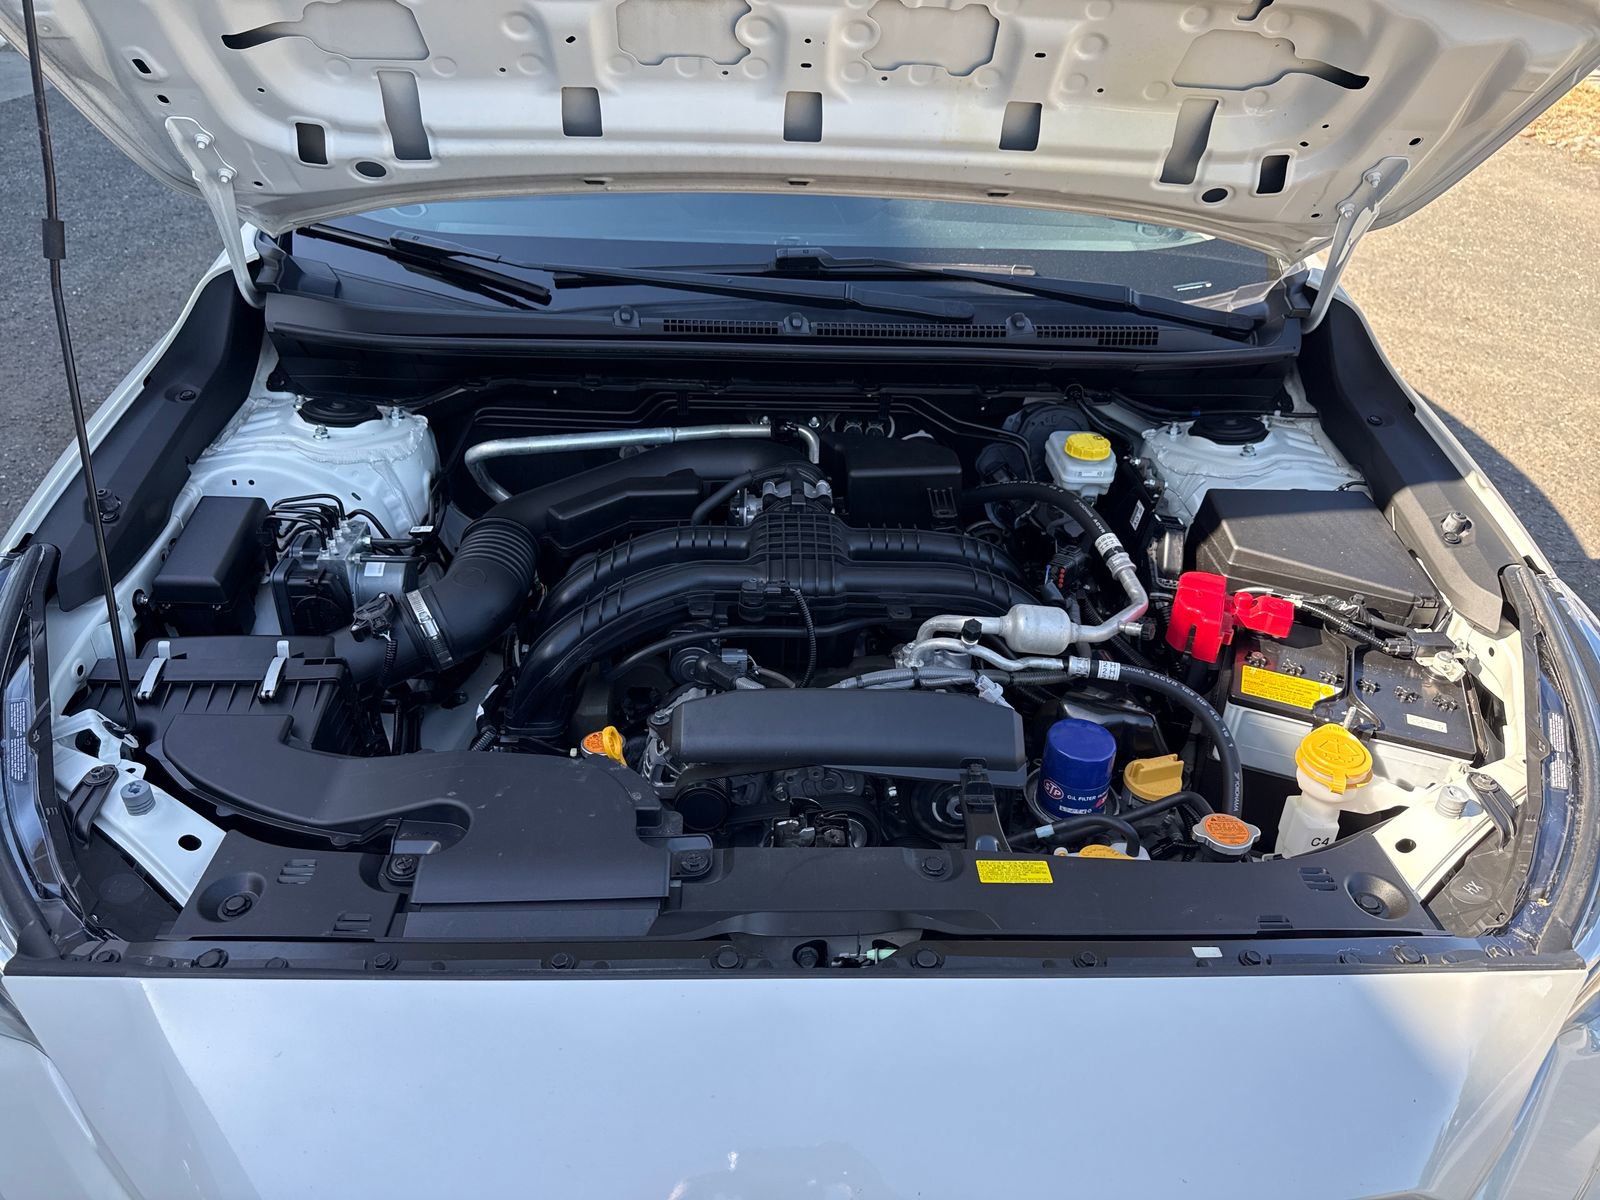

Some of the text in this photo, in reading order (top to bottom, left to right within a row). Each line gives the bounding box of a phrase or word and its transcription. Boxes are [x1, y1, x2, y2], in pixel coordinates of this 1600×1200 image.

[1044, 781, 1062, 797] STP
[1311, 837, 1330, 847] C4
[1462, 880, 1484, 895] HX
